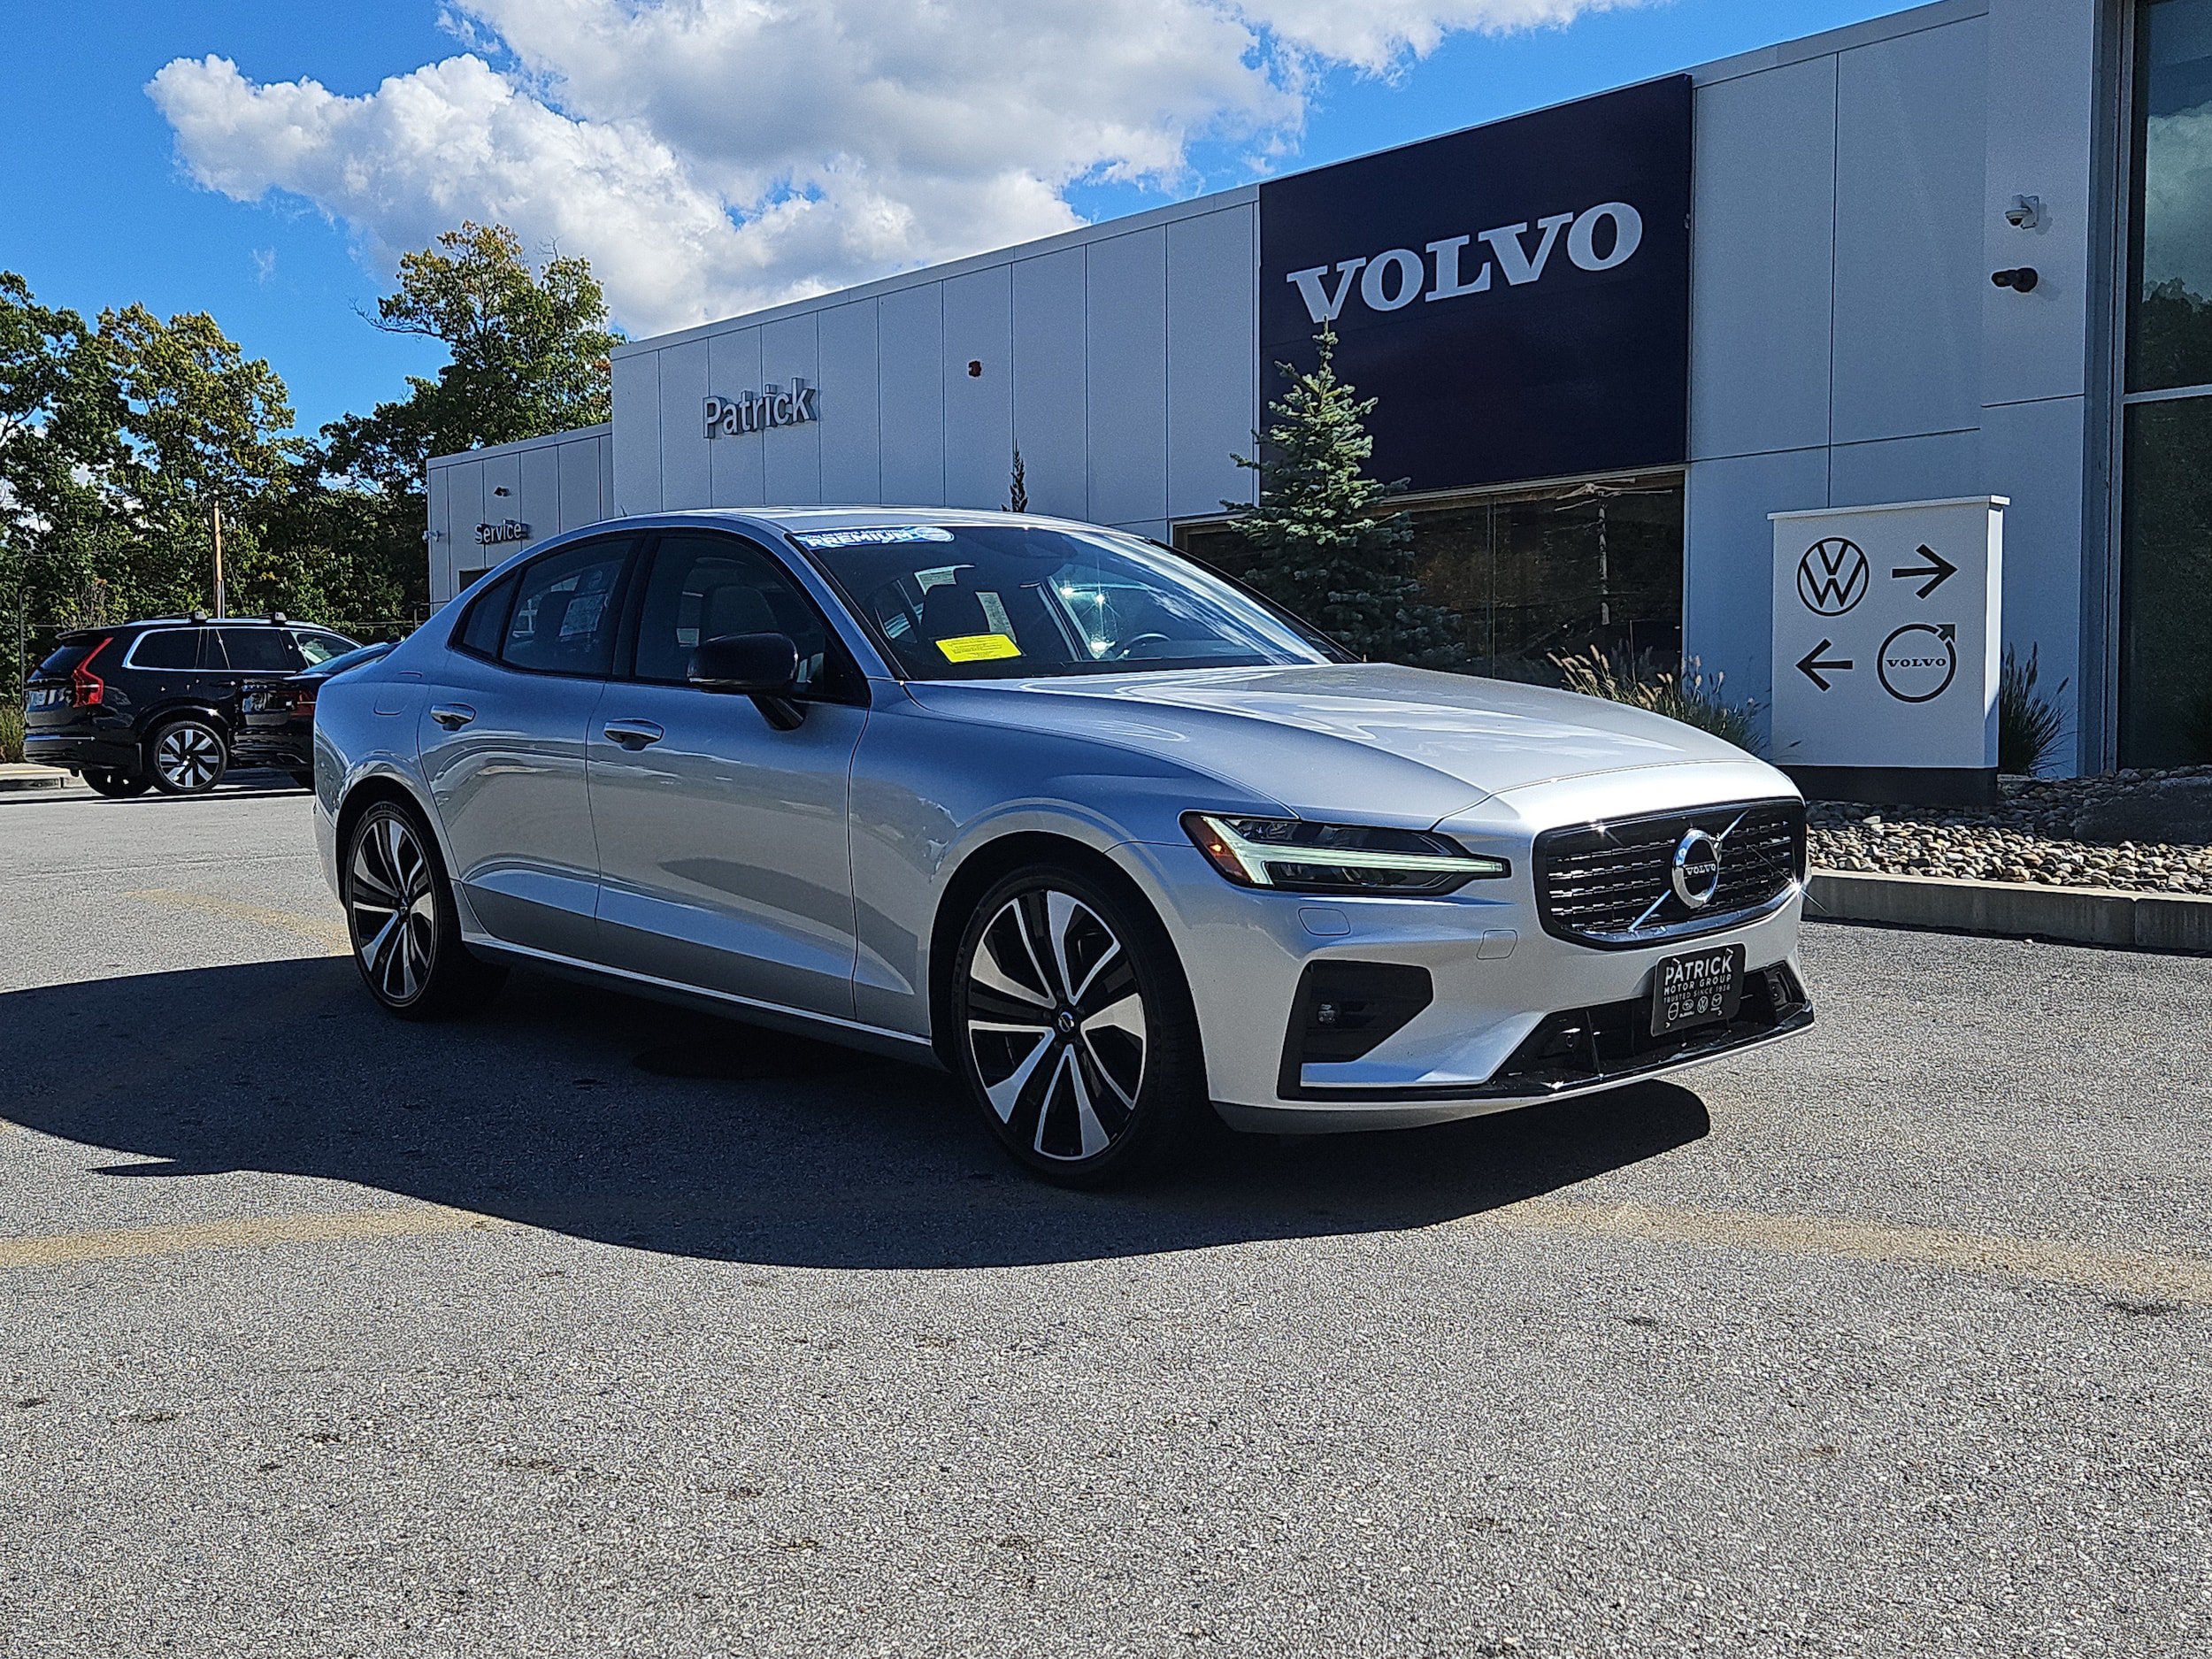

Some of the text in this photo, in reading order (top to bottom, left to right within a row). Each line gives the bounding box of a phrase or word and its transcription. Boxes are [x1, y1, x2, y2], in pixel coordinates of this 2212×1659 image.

[1286, 202, 1643, 323] VOLVO
[703, 377, 816, 439] Patrick
[474, 518, 526, 545] Service
[806, 530, 913, 547] PREMIUM
[1886, 657, 1947, 667] VOLVO
[1686, 864, 1717, 875] VOLVO
[1664, 955, 1733, 986] PATRICK
[1663, 973, 1732, 996] MOTOR GROUP
[1663, 992, 1692, 1003] TRUSTED
[1693, 987, 1713, 997] SINCE
